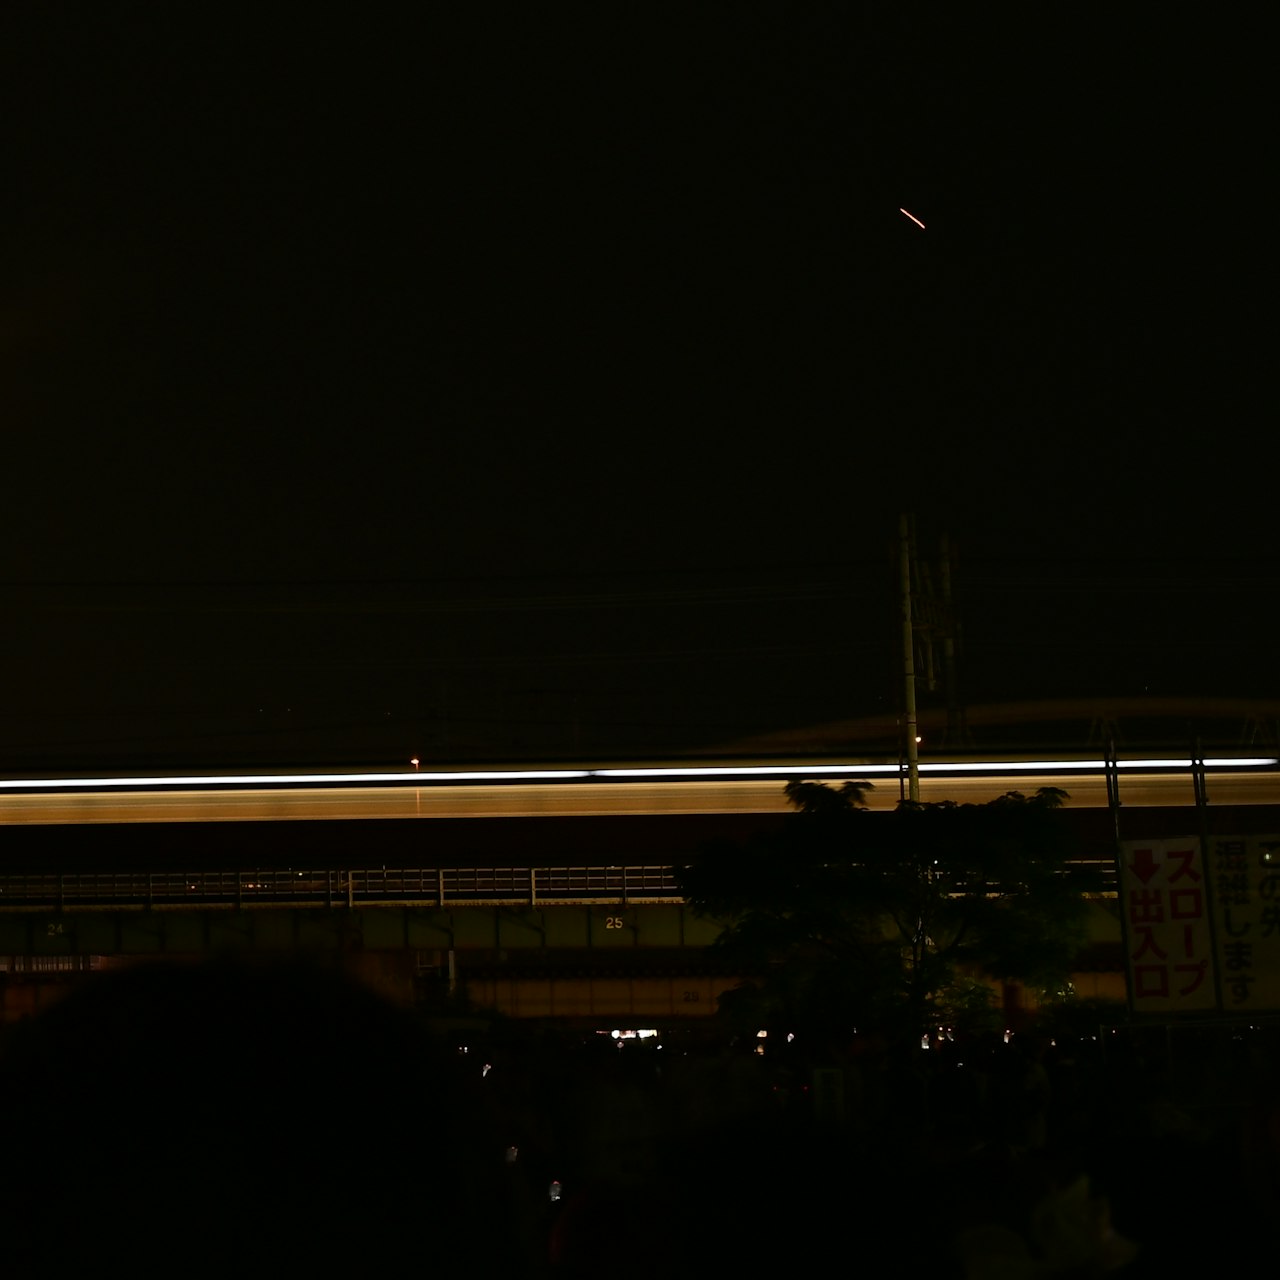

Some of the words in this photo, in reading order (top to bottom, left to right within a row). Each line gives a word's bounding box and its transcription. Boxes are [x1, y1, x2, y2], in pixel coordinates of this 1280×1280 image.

[605, 916, 624, 929] 25
[1130, 888, 1169, 998] 出入口
[1167, 849, 1209, 997] スロープ
